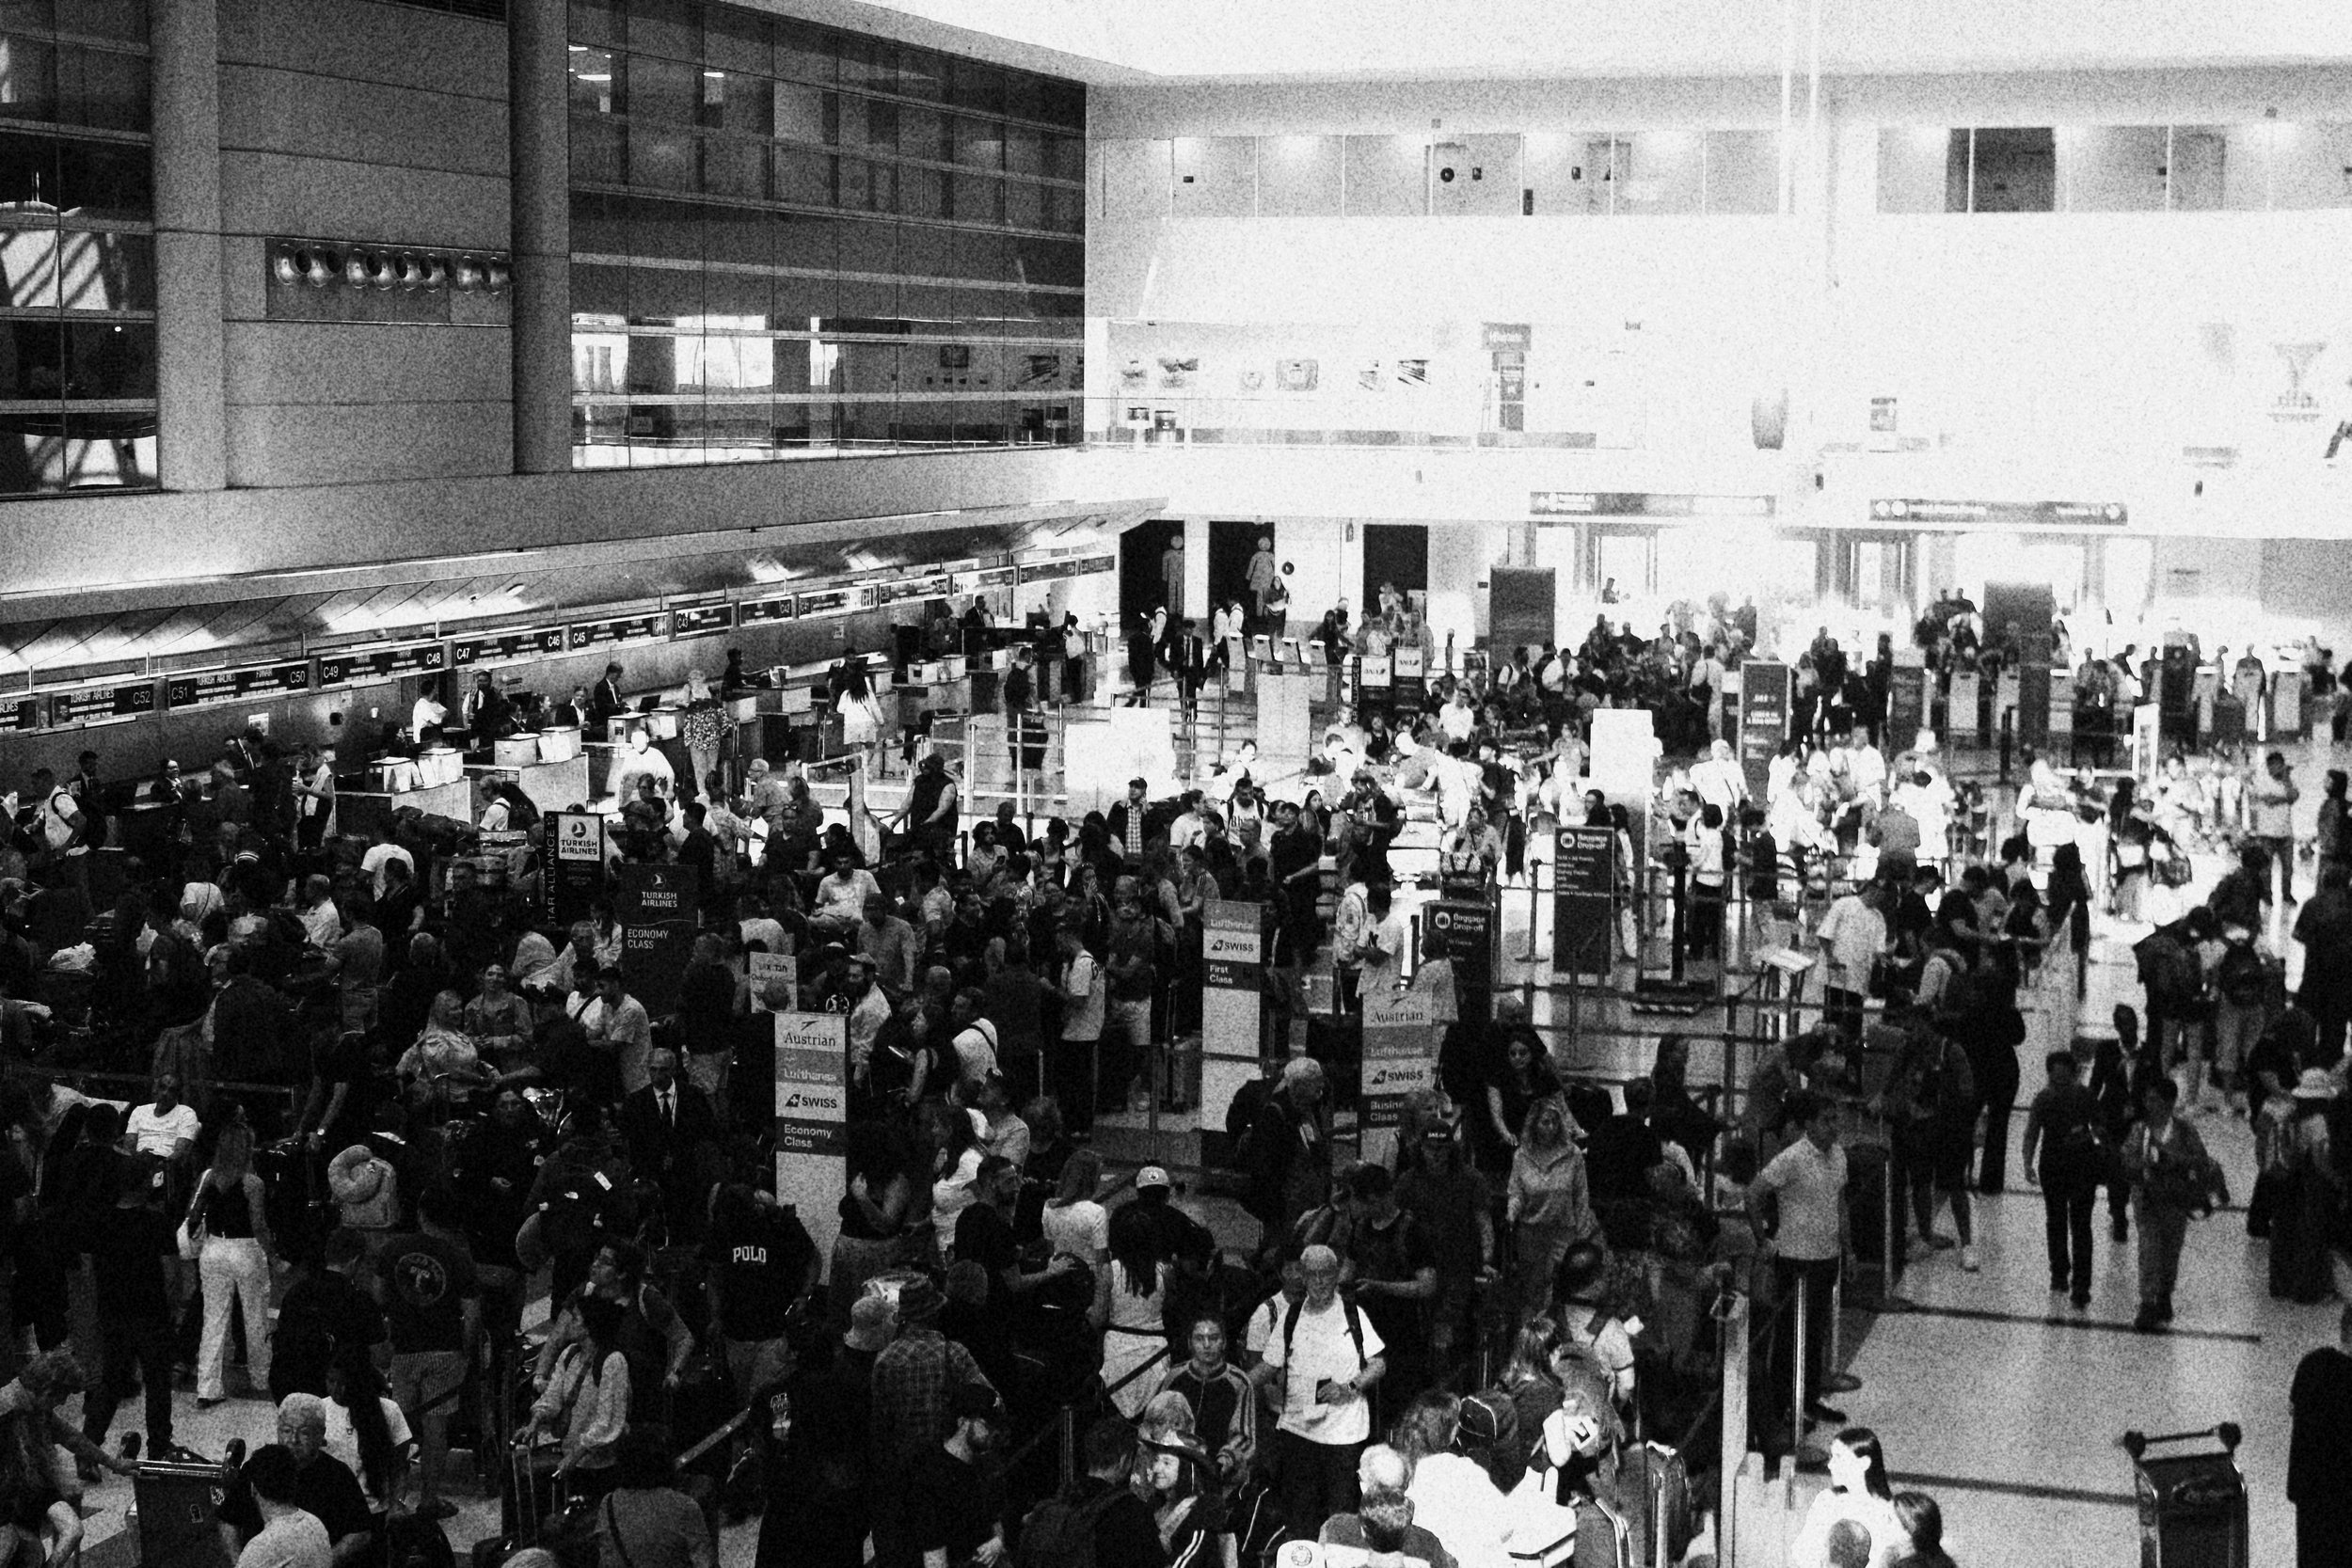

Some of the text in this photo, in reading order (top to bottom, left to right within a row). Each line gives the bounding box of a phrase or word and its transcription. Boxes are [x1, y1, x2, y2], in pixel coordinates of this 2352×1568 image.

[548, 635, 561, 647] C46
[573, 632, 586, 644] C45
[426, 652, 441, 665] C48
[456, 647, 470, 660] C47
[290, 671, 306, 684] C50
[323, 665, 339, 678] C49
[133, 690, 151, 705] C52
[171, 686, 188, 700] C51
[561, 839, 597, 847] TURKISH
[561, 847, 597, 855] AIRLINES
[547, 829, 557, 894] ALLIANCE
[642, 891, 677, 900] TURKISH
[641, 899, 678, 908] AIRLINES
[1453, 912, 1486, 924] Baggage
[1453, 922, 1485, 932] Drop-off
[628, 928, 669, 940] ECONOMY
[628, 940, 655, 949] CLASS
[1224, 942, 1254, 952] SWISS
[1209, 964, 1229, 974] First
[1209, 974, 1233, 985] Class
[1371, 1010, 1423, 1022] Austrian
[784, 1031, 836, 1046] Austrian
[784, 1068, 837, 1083] Lufthansa
[1388, 1070, 1423, 1082] SWISS
[802, 1096, 837, 1109] SWISS
[1370, 1100, 1405, 1110] Busine
[1370, 1112, 1399, 1122] Class
[784, 1123, 833, 1139] Economy
[784, 1135, 813, 1148] Class
[732, 1245, 767, 1263] POLO
